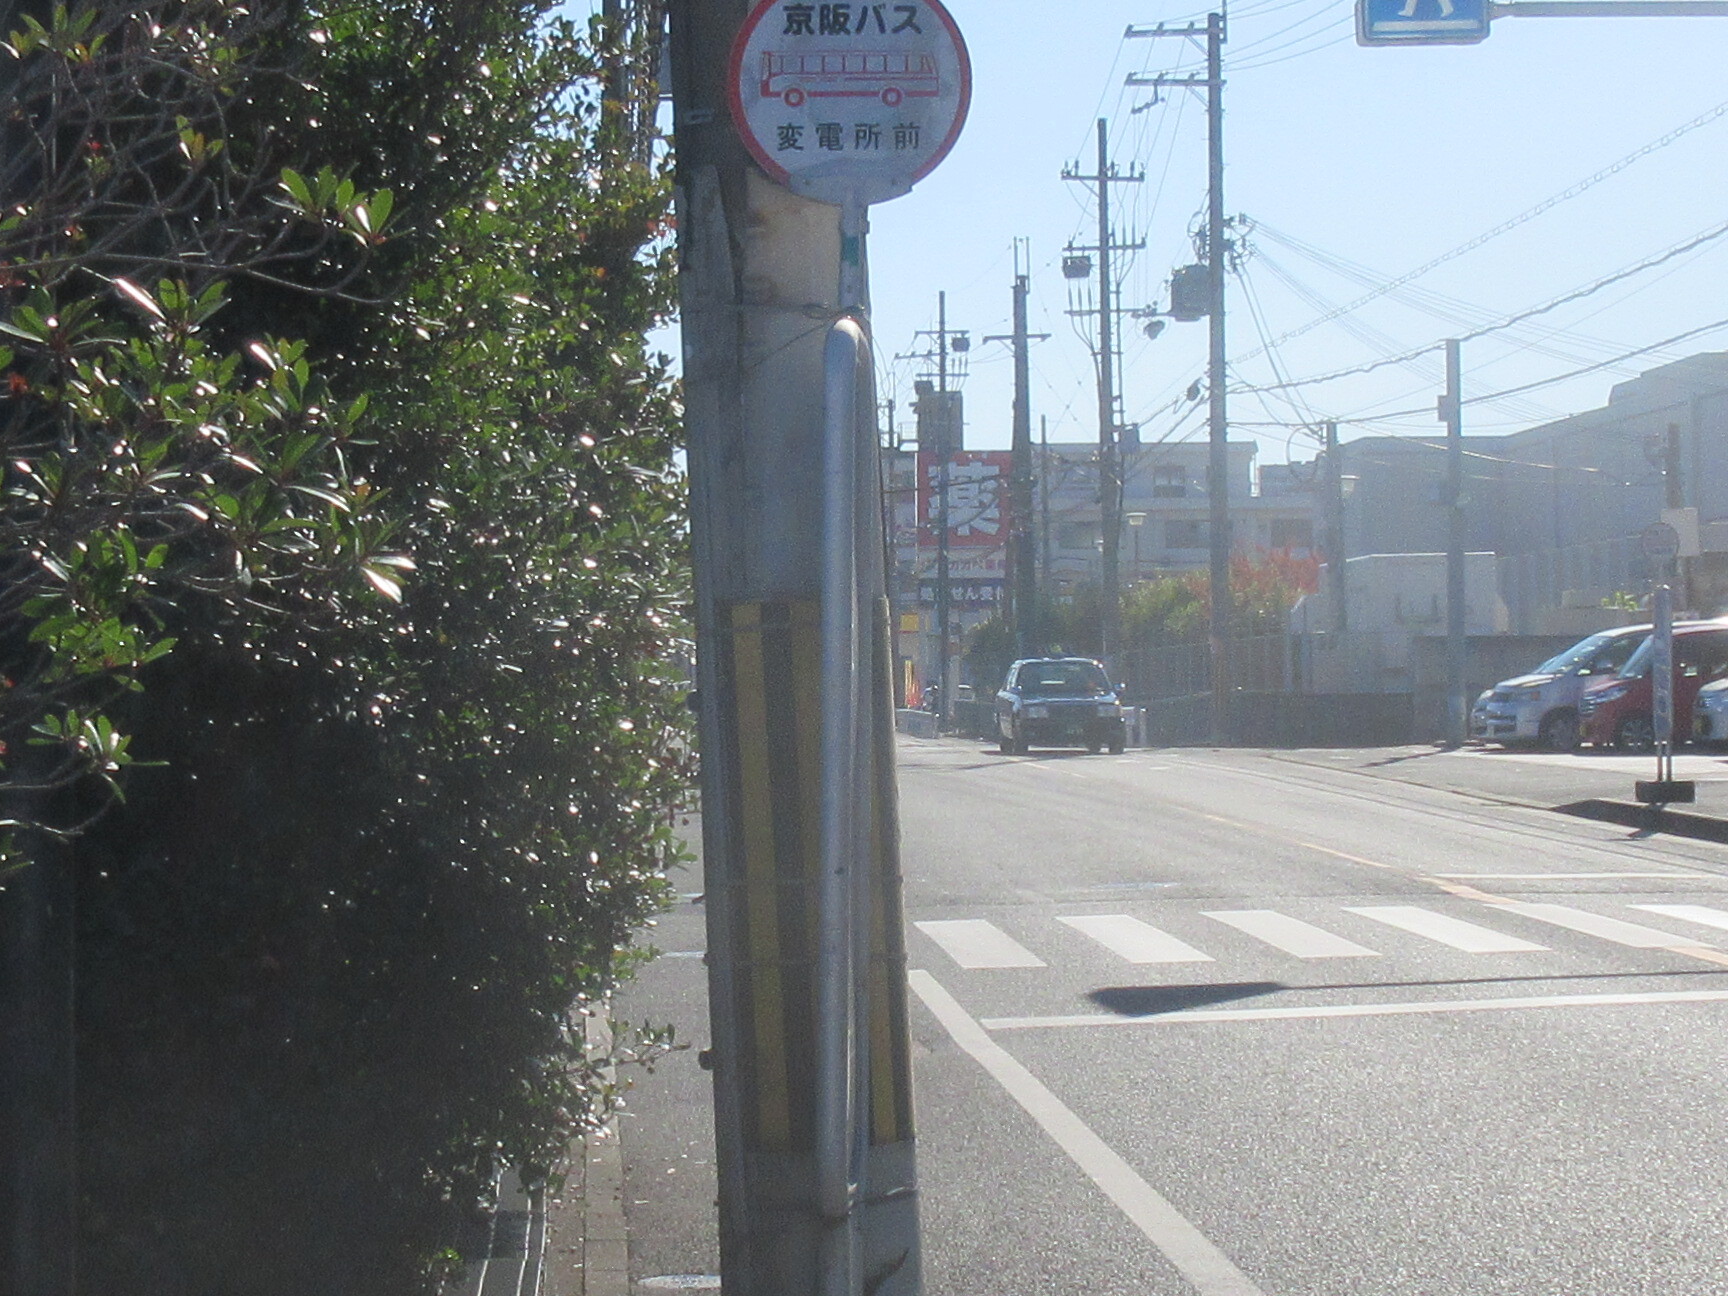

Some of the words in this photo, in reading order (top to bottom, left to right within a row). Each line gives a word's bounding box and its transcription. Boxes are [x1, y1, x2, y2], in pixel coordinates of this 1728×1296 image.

[783, 4, 922, 36] 京阪バス
[776, 123, 920, 152] 変電所前
